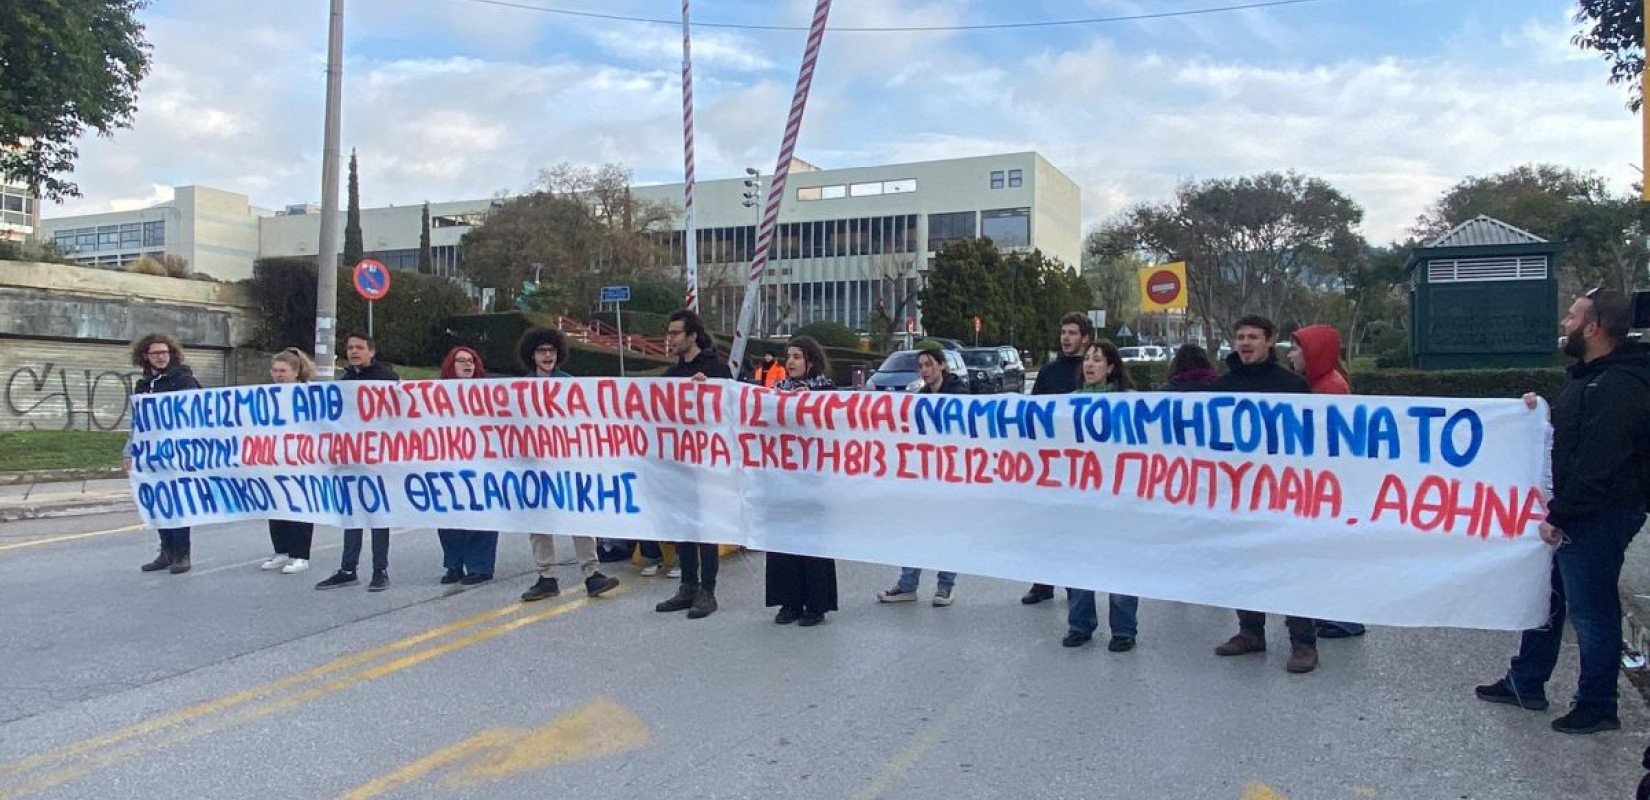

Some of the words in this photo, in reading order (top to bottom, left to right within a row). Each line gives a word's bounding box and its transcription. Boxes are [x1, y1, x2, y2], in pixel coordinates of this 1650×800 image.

[293, 384, 343, 423] ΑΠΘ
[357, 385, 400, 422] ΟΧΙ
[405, 382, 455, 418] ΣΤΑ
[458, 380, 590, 418] ΙΔΙΩΤΙΚΑ
[1069, 396, 1314, 457] ΤΟΛΜΗΣΟΥΝ
[1326, 404, 1400, 460] ΝΑ
[1407, 406, 1483, 468] ΤΟ
[137, 475, 278, 520] ΦΟΙΤΗΤΙΚΟΙ
[272, 473, 390, 516] ΣΥΛΛΟΓΟΙ
[404, 469, 641, 516] ΘΕΣΣΑΛΟΝΙΚΗΣ
[480, 423, 650, 460] ΣΥΛΛΑΛΗΤΗΡΙΟ
[1035, 447, 1104, 492] ΣΤΑ
[1370, 472, 1550, 541] ΑΘΗΝΑ
